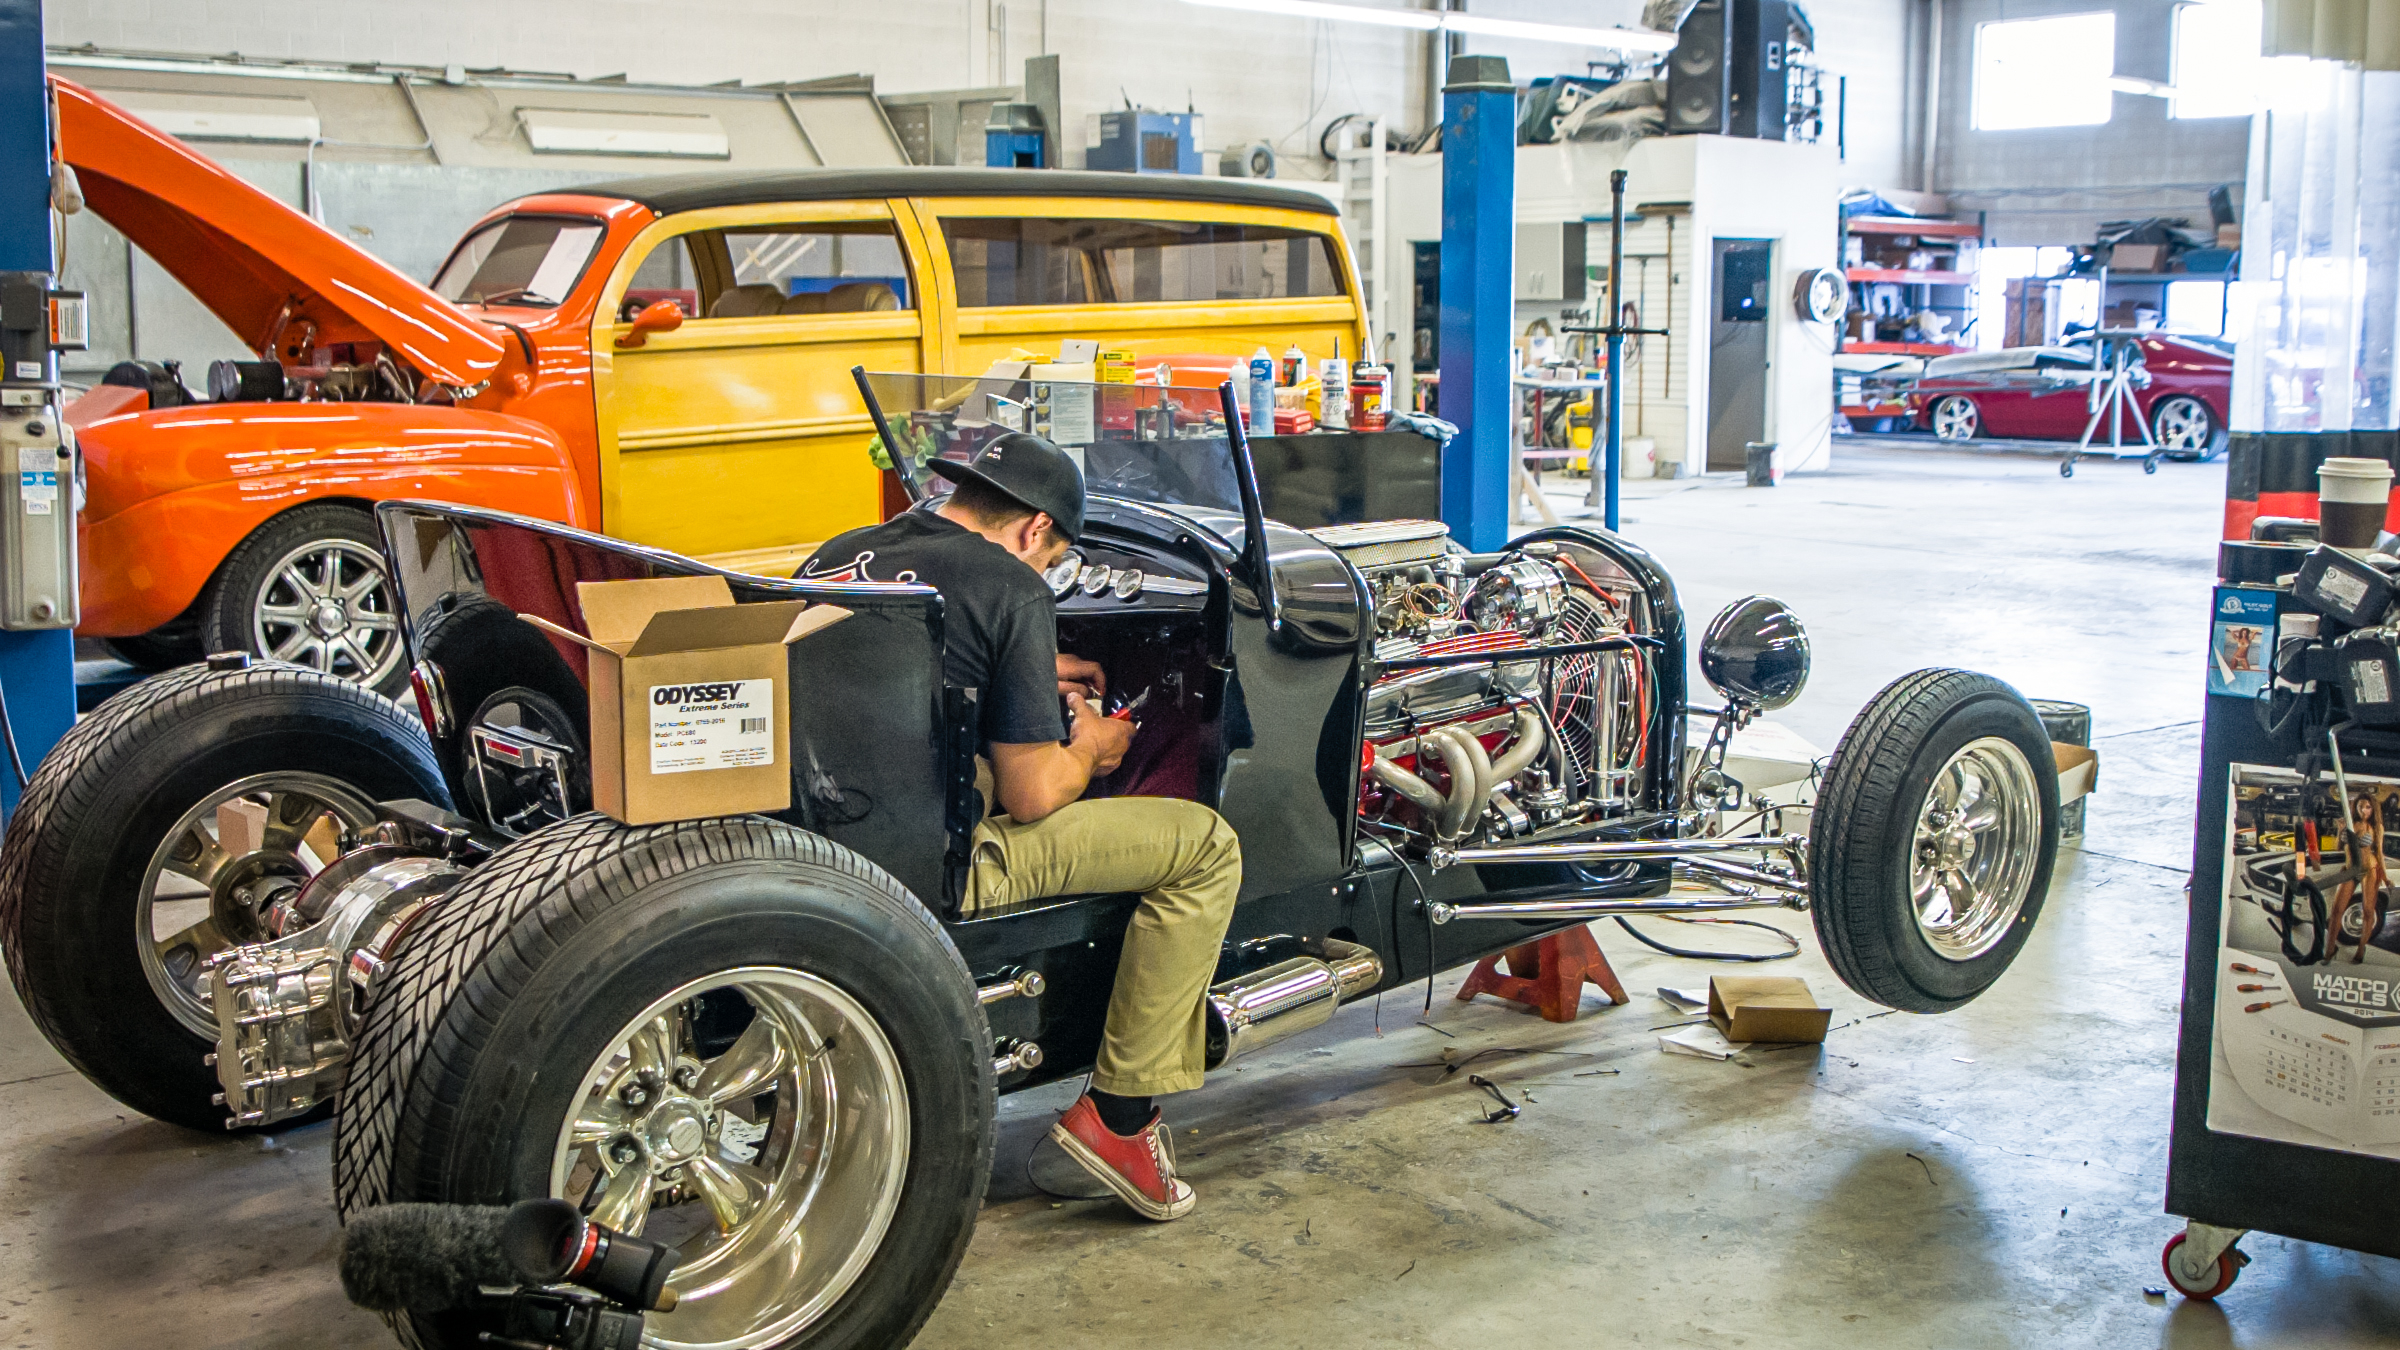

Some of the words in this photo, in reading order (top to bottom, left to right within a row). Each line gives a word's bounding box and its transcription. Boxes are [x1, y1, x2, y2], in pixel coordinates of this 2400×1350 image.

[654, 683, 742, 705] ODYSSEY
[679, 704, 718, 712] Extreme
[721, 702, 750, 710] Series
[2314, 973, 2388, 993] MATCO
[2313, 986, 2388, 1006] TOOLS
[2354, 1008, 2374, 1016] 2014
